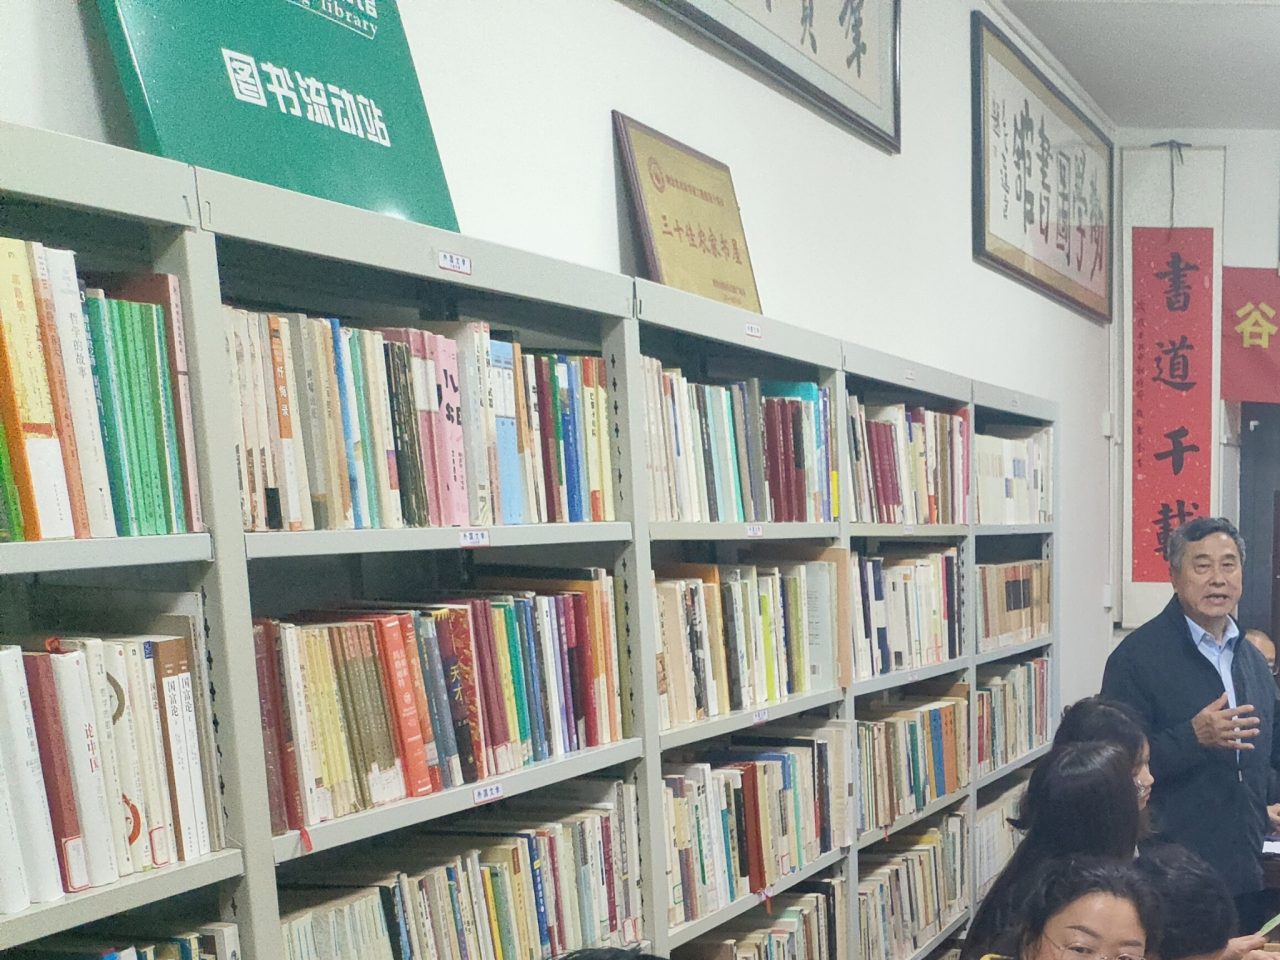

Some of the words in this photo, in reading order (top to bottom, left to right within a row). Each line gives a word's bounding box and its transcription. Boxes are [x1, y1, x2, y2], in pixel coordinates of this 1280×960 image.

[220, 47, 391, 147] 图书流动站
